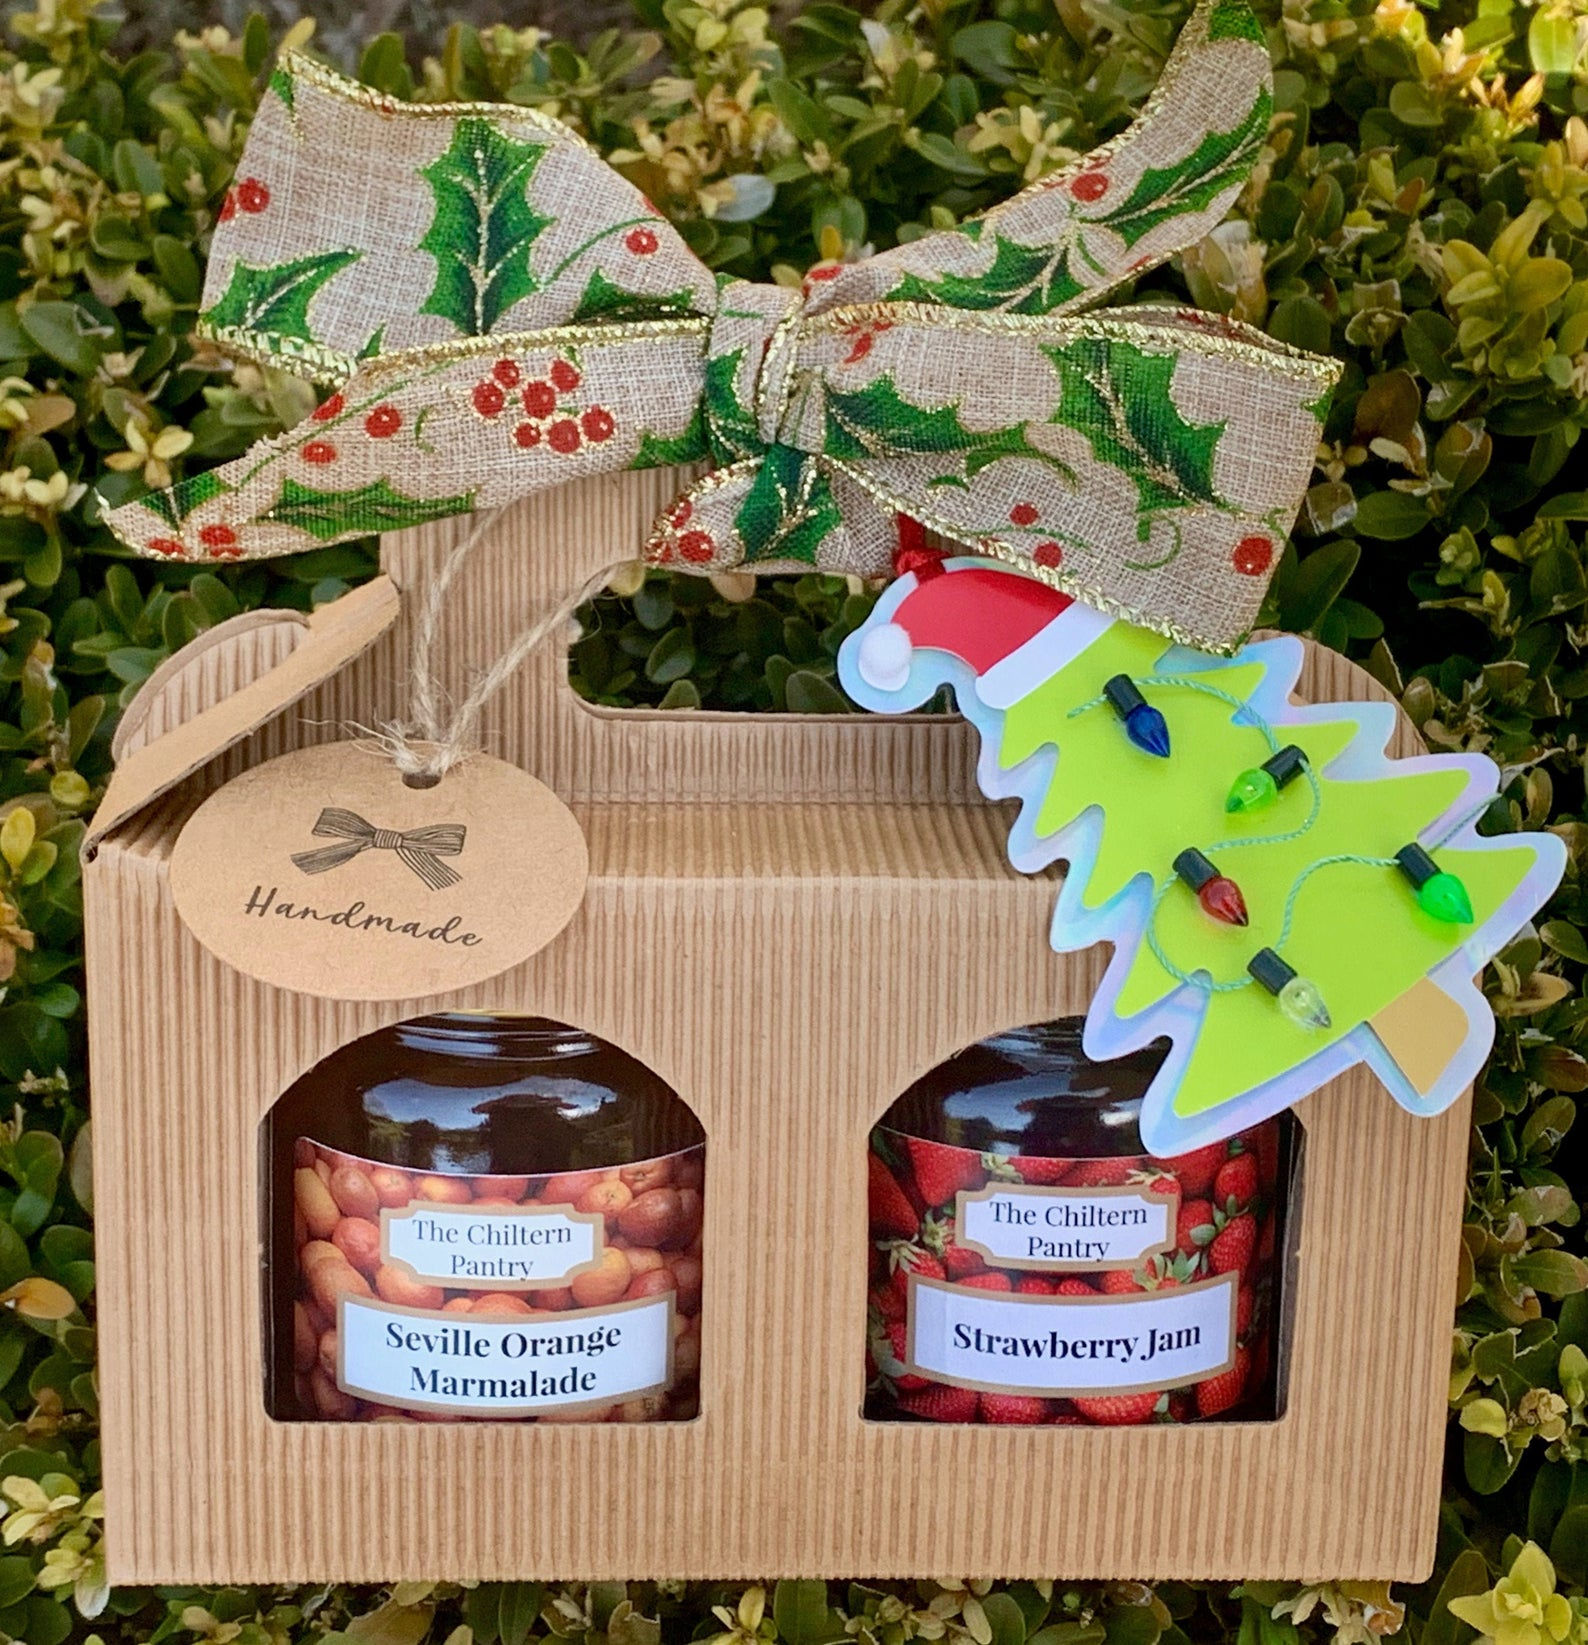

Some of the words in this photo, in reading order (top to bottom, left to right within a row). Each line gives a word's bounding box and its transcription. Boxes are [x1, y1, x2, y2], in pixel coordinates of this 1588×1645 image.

[244, 885, 483, 947] Handmade
[990, 1201, 1037, 1225] The
[1044, 1204, 1148, 1228] Chiltern
[412, 1219, 459, 1244] The
[467, 1223, 572, 1246] Chiltern
[1027, 1236, 1111, 1263] Pantry
[450, 1254, 534, 1282] Pantry
[385, 1321, 491, 1358] Seville
[501, 1325, 622, 1359] Orange
[953, 1322, 1139, 1363] Strawberry
[1140, 1324, 1202, 1361] Jam
[409, 1365, 597, 1399] Marmalade
